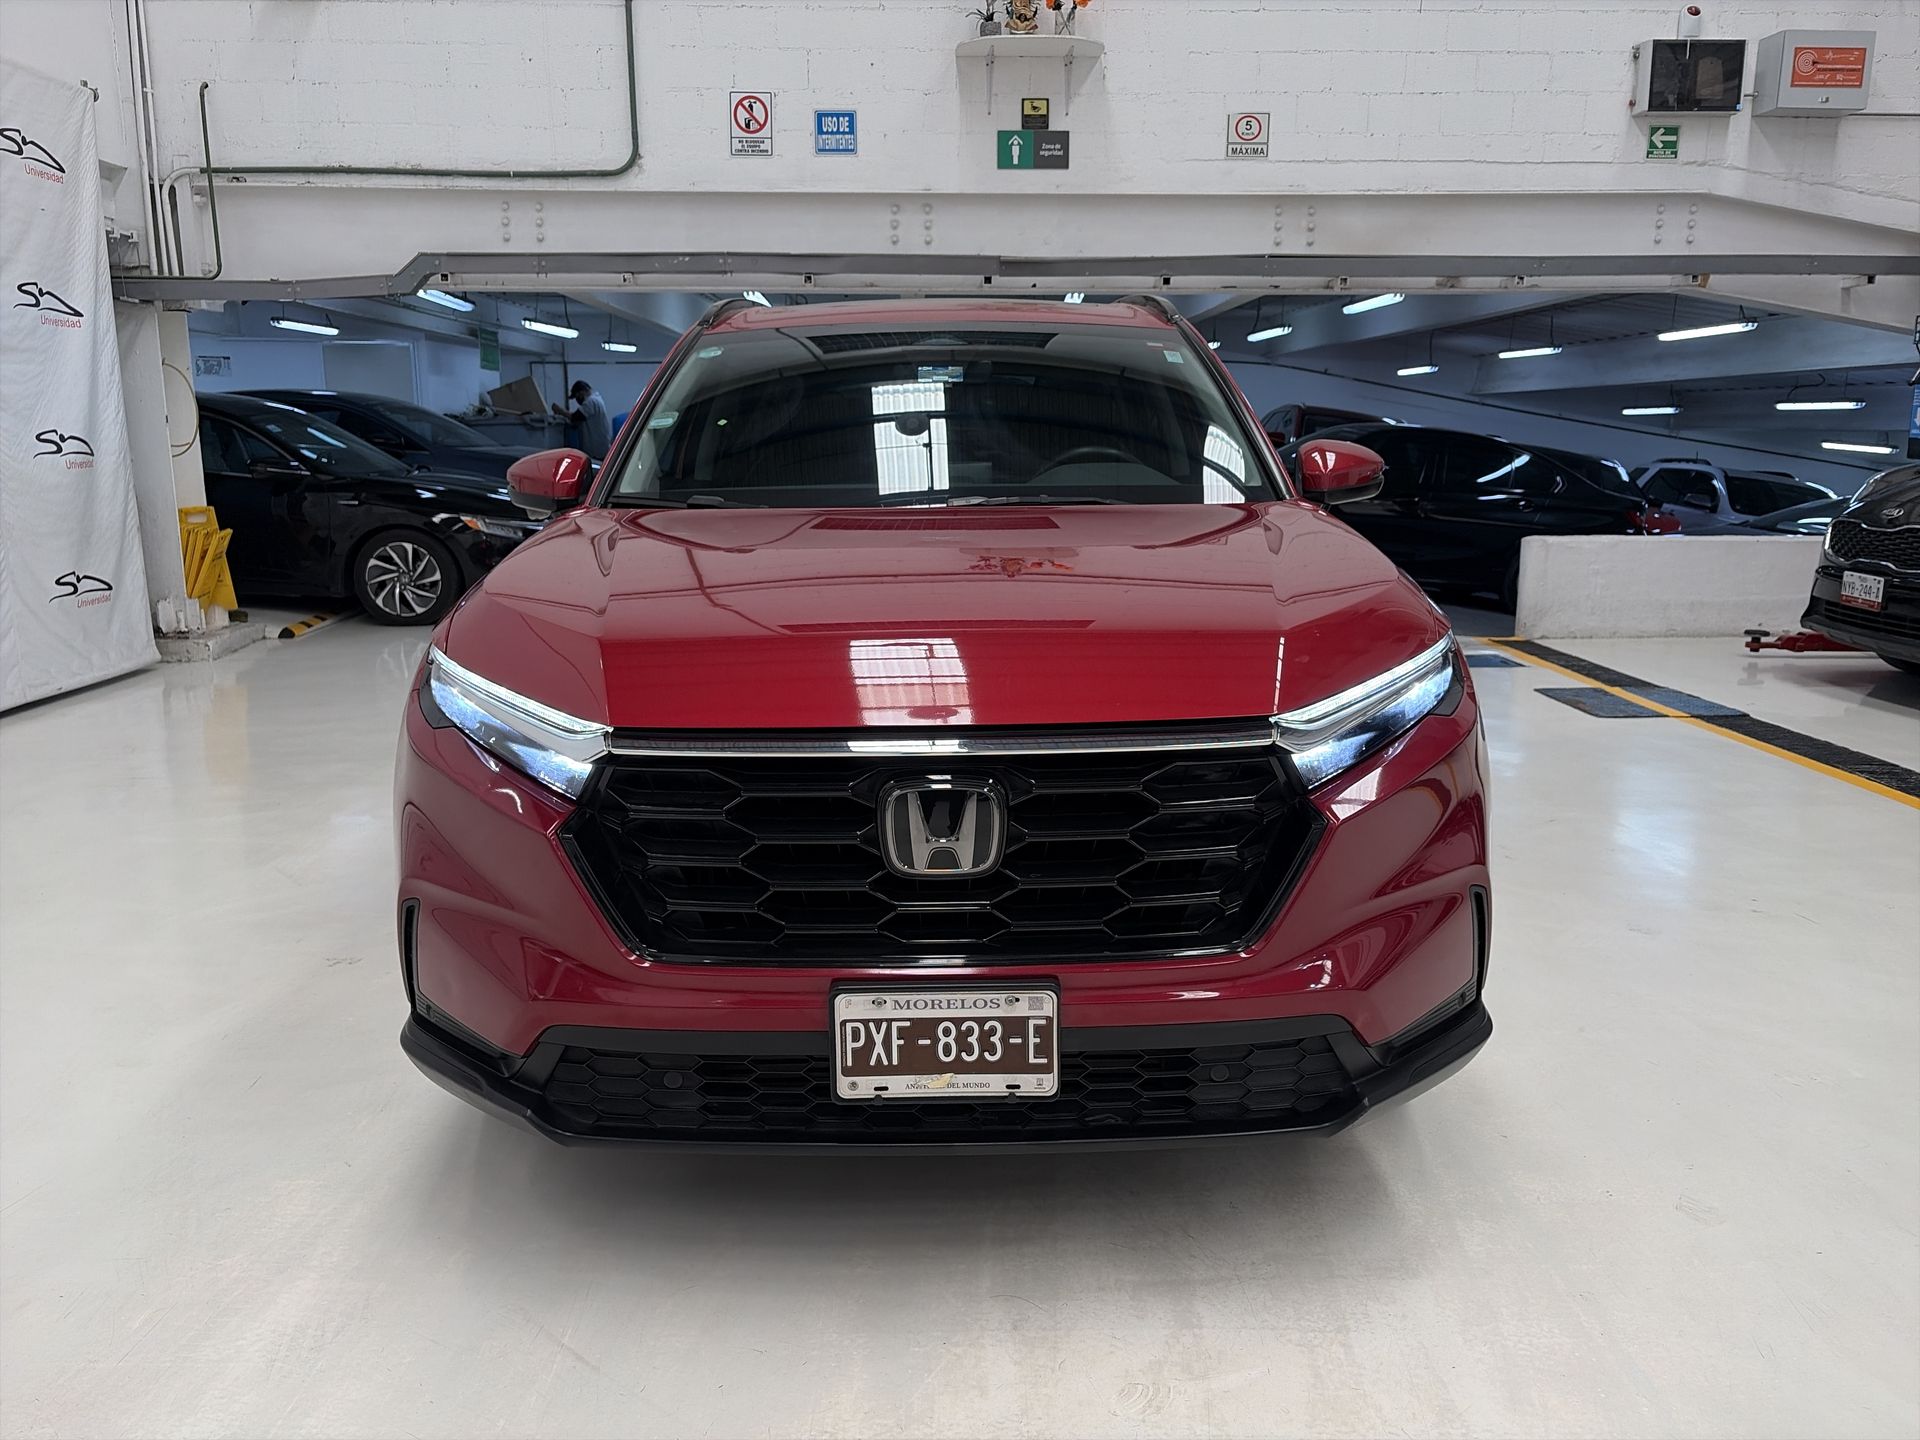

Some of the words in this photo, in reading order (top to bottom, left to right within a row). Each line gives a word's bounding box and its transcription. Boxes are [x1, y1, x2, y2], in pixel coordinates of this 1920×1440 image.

[822, 116, 838, 132] USO
[839, 117, 849, 132] DE
[1244, 120, 1253, 131] 5
[1039, 149, 1064, 157] seguridad
[1231, 144, 1265, 155] MÁXIMA
[25, 163, 64, 184] Universidad
[41, 314, 82, 328] Universidad
[77, 591, 111, 608] Universidad
[891, 997, 1002, 1010] MORELOS
[846, 1019, 1048, 1067] PXF-833-E
[947, 1081, 961, 1089] DEL
[962, 1081, 991, 1089] MUNDO
